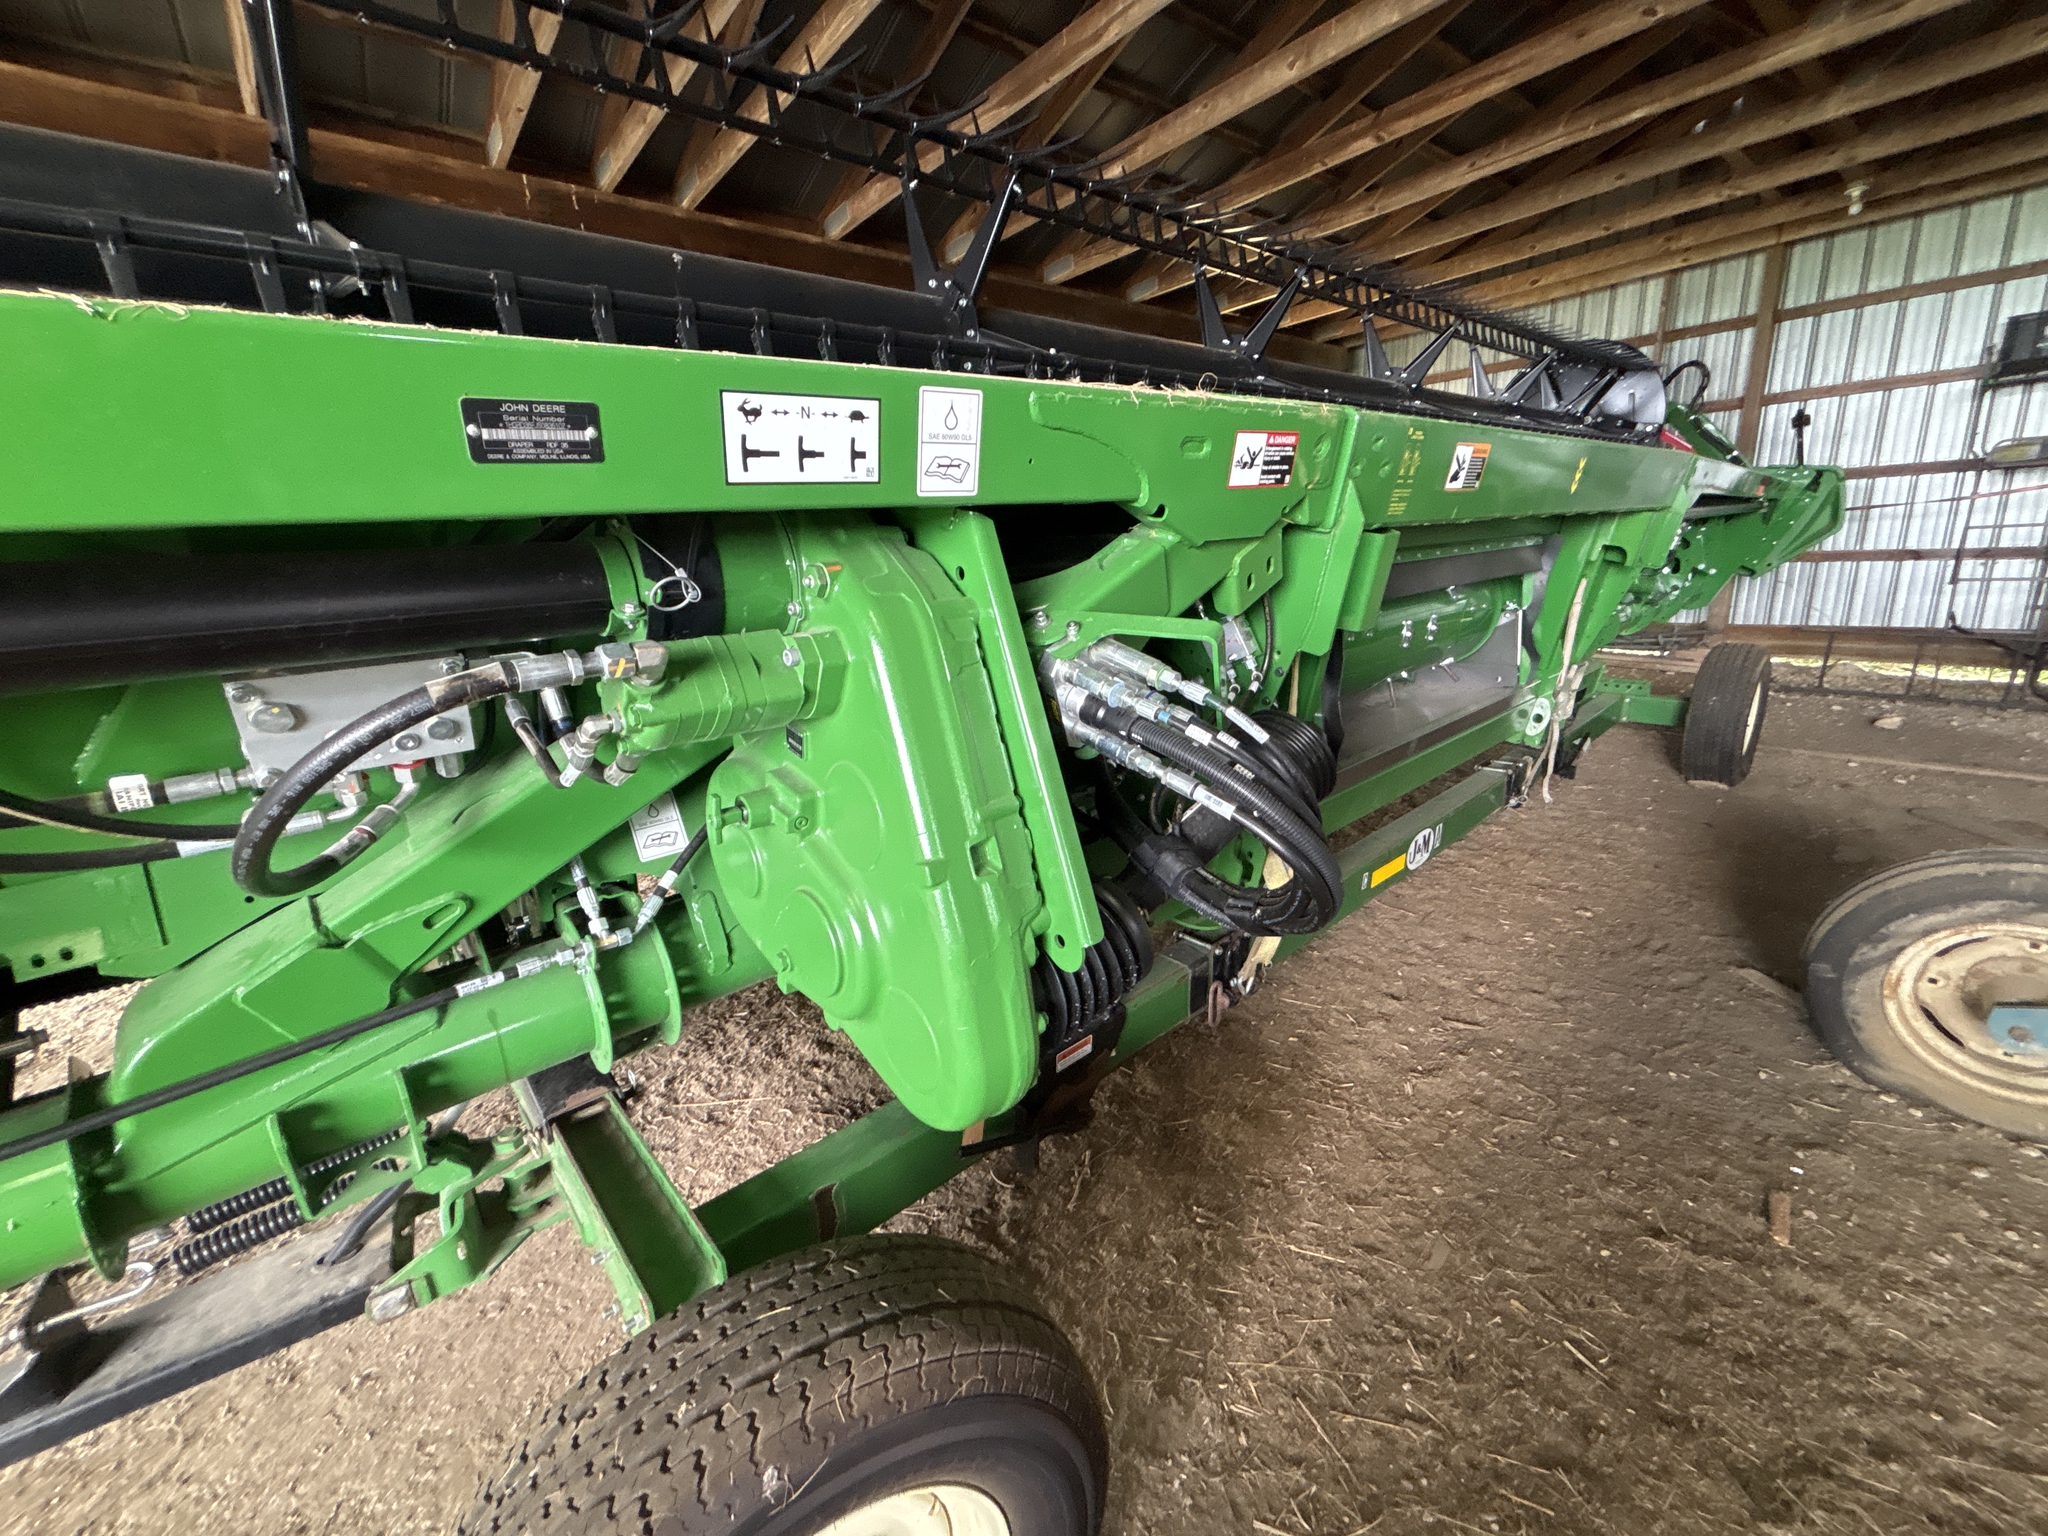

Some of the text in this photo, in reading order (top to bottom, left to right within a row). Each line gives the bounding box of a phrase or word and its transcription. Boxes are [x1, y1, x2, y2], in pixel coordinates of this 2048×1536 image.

[499, 402, 566, 413] JOHN DEERE
[502, 414, 566, 423] Serial Number
[928, 432, 940, 440] SAE
[1274, 435, 1296, 444] DANGER
[1409, 831, 1432, 864] J&M
